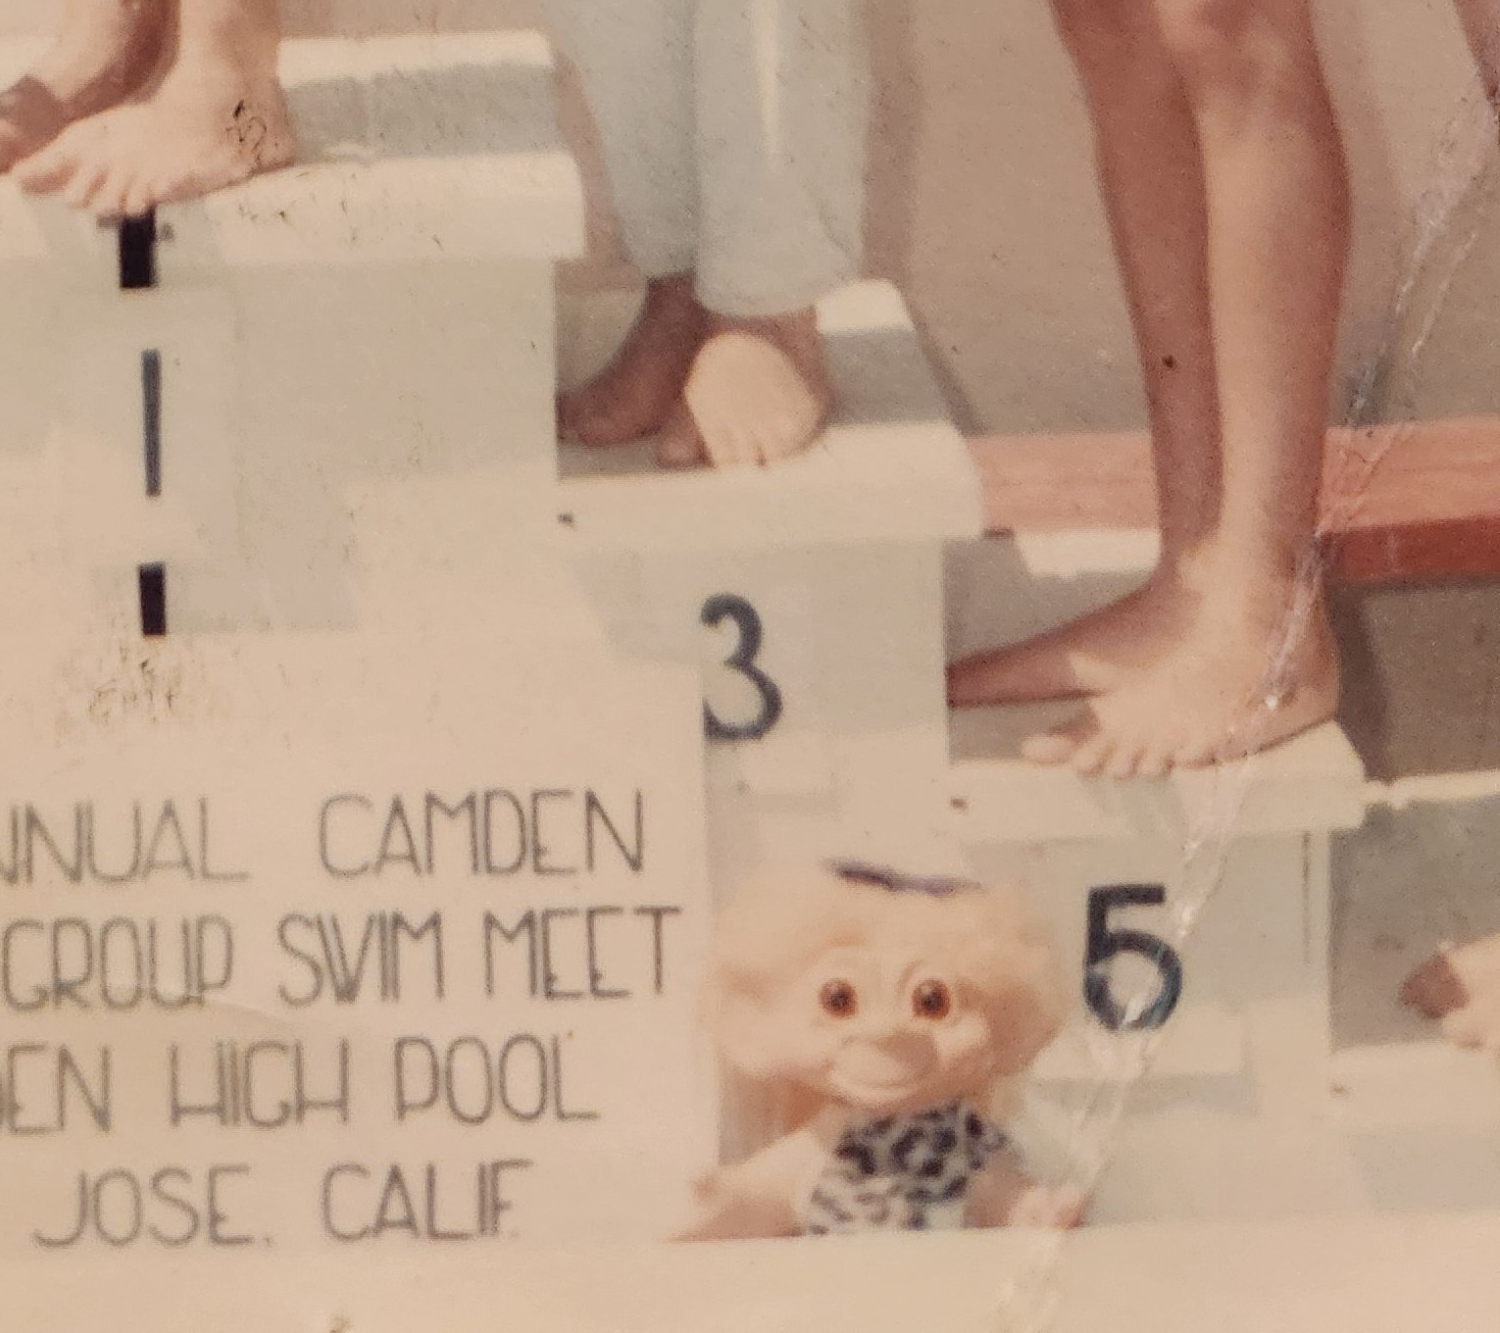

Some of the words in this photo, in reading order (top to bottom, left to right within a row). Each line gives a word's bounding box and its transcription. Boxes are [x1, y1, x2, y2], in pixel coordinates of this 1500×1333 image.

[700, 593, 784, 739] 3
[317, 788, 645, 881] CAMDEN
[0, 912, 235, 1015] GROUP
[277, 910, 445, 1006] SWIM
[483, 905, 684, 1002] MEET
[1082, 883, 1184, 1034] 5
[170, 1036, 350, 1130] HIGH
[394, 1032, 602, 1125] POOL
[320, 1158, 536, 1244] CALIF
